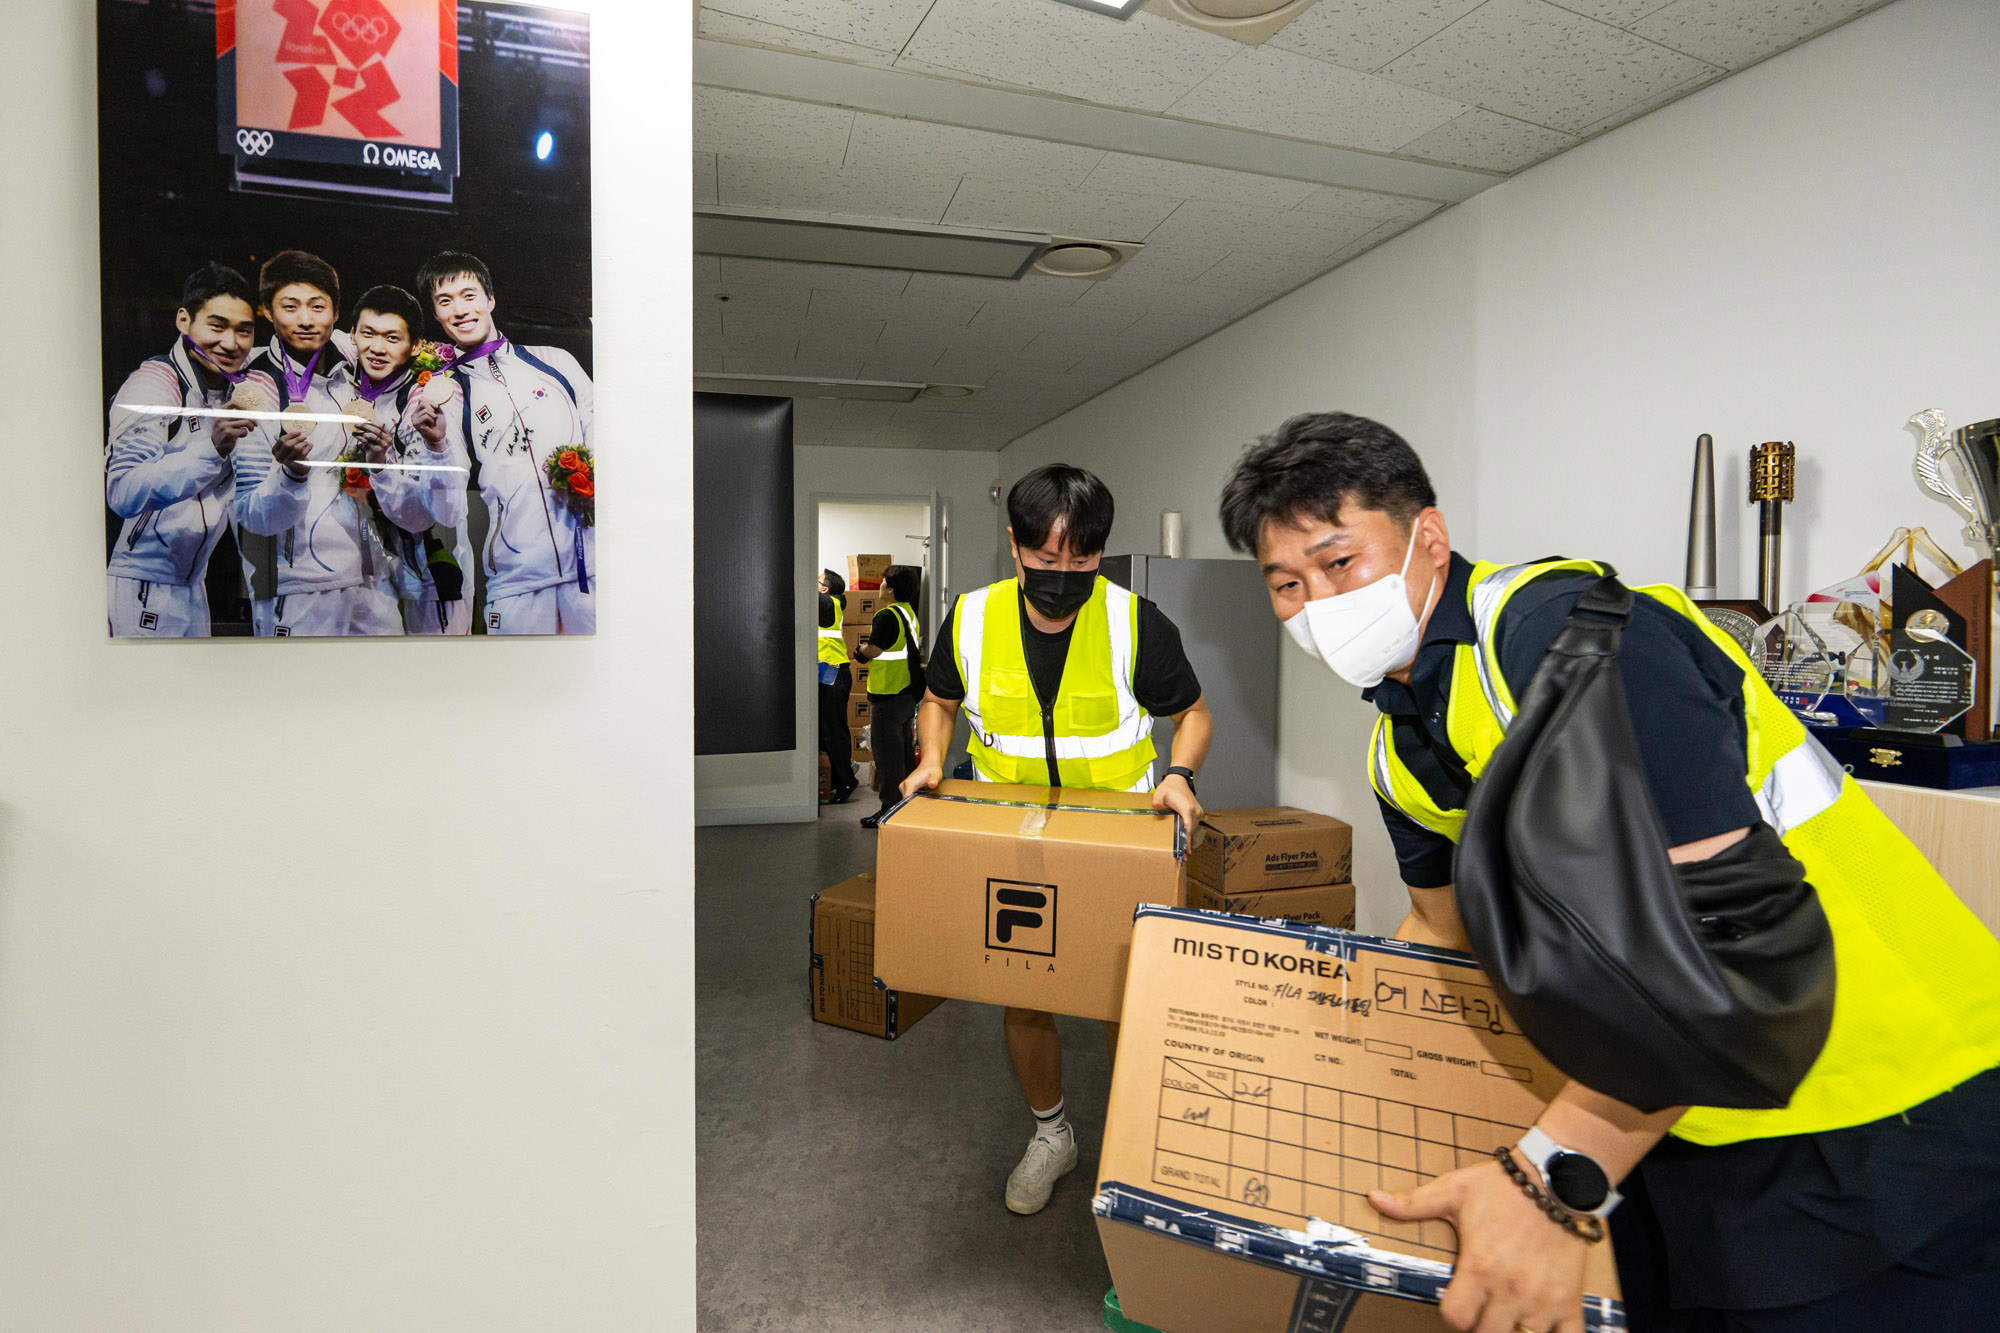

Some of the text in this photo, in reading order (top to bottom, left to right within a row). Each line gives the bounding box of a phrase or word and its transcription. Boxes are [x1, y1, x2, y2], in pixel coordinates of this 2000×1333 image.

[383, 147, 442, 171] OMEGA
[1281, 853, 1299, 862] Flyer
[1301, 851, 1318, 859] Pack
[1303, 912, 1321, 920] Pack
[984, 954, 1055, 973] FILA
[1235, 979, 1256, 989] STYLE
[1243, 996, 1268, 1006] COLOR
[1420, 987, 1505, 1035] 스타킹
[1314, 1031, 1329, 1040] NET
[1164, 1039, 1265, 1064] COUNTRY OF ORIGIN
[1416, 1050, 1443, 1062] GROSS
[1206, 1070, 1229, 1081] SIZE
[1160, 1164, 1222, 1189] GRAND TOTAL
